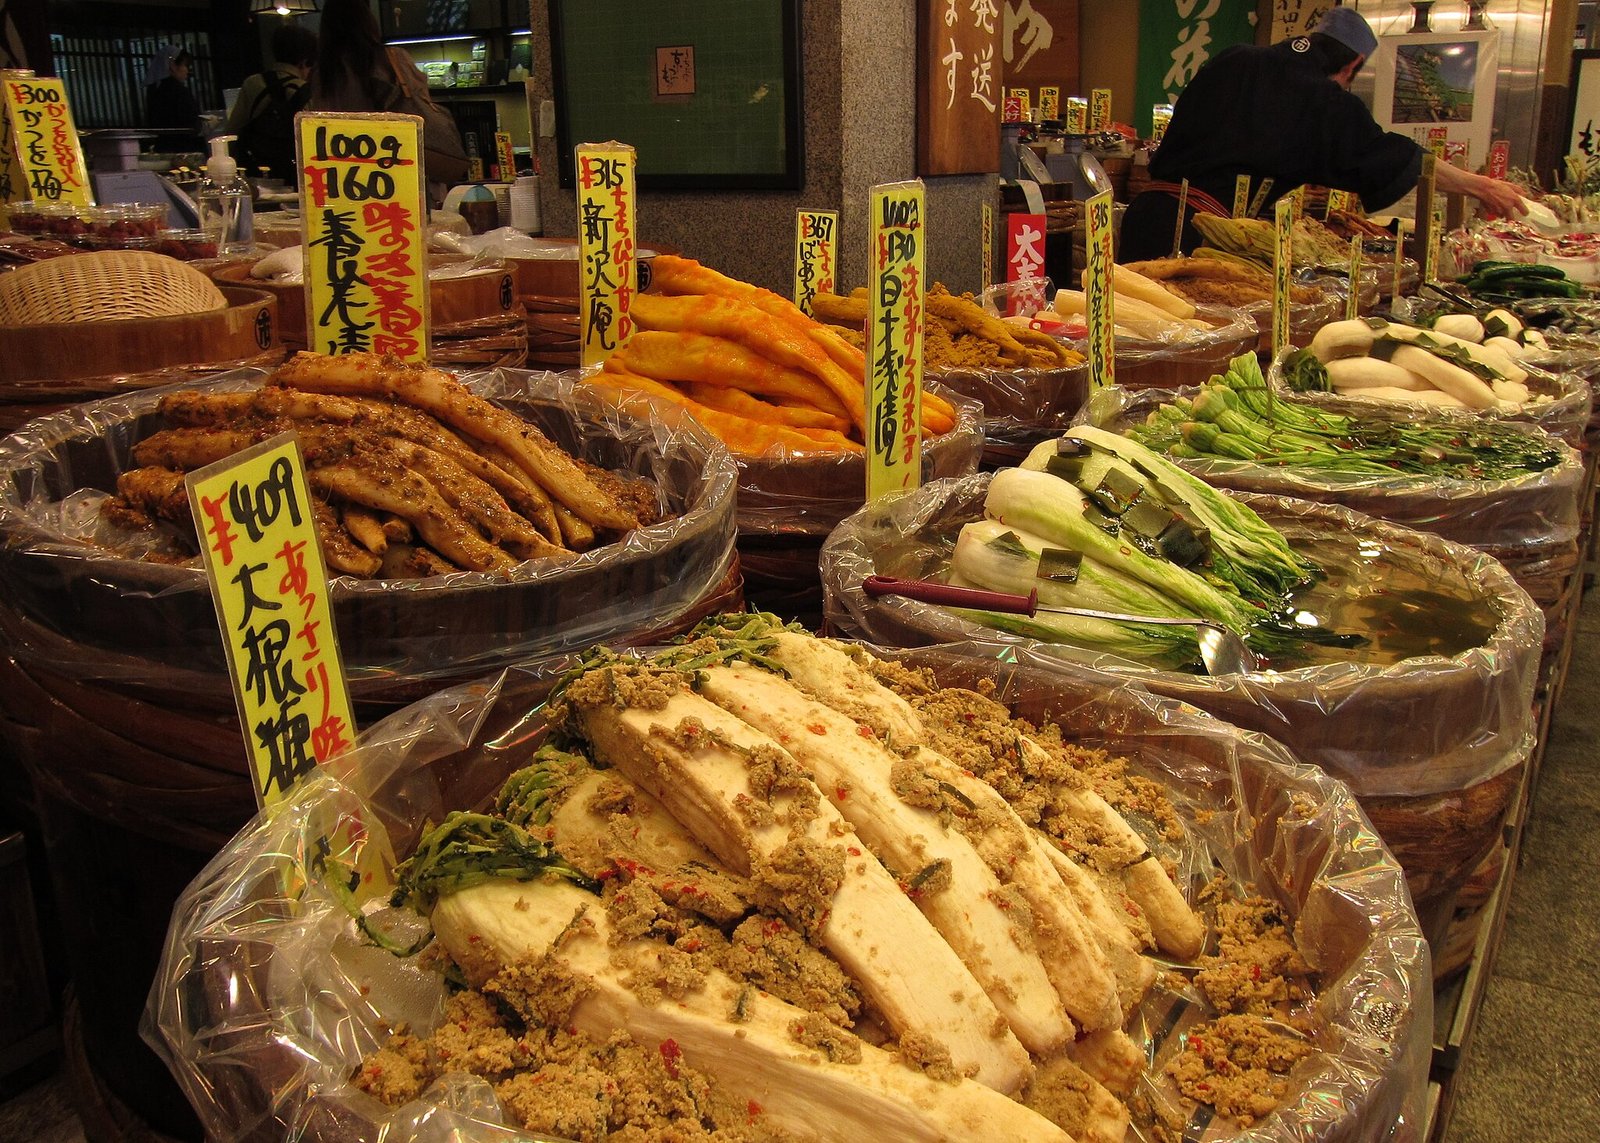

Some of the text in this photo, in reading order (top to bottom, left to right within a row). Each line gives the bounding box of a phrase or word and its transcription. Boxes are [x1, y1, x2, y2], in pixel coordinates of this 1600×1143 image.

[315, 126, 402, 169] 100g
[304, 165, 395, 208] ¥160
[580, 156, 627, 190] ¥315
[801, 214, 834, 242] ¥367
[878, 233, 917, 271] ¥130
[582, 198, 617, 350] 新沢庵
[202, 457, 302, 566] ¥409
